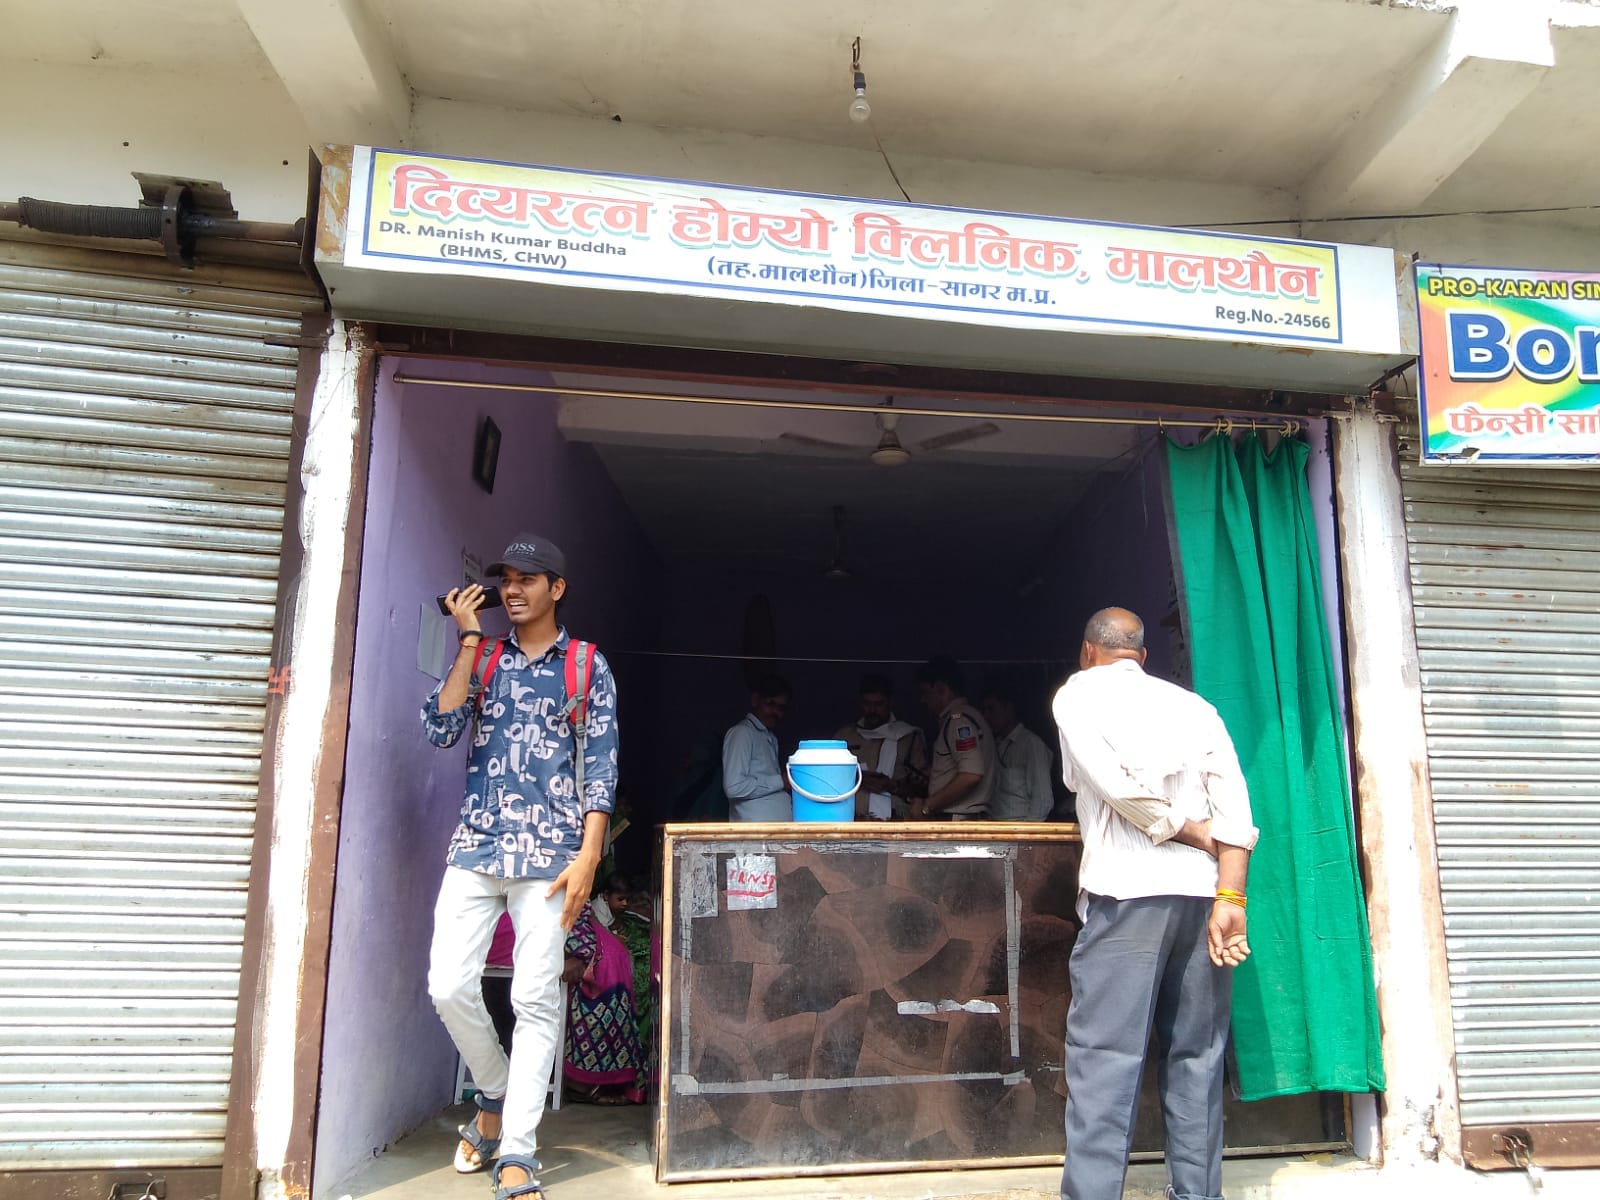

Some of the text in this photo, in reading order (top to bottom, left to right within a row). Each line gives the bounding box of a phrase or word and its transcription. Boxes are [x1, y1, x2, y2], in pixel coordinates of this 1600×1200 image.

[378, 220, 627, 256] DR. Manish Kumar Buddha
[671, 197, 836, 253] होम्यो
[1107, 246, 1321, 299] मालथौन
[439, 243, 567, 269] (BHMS, CHW)
[1428, 277, 1568, 299] PRO-KARAN
